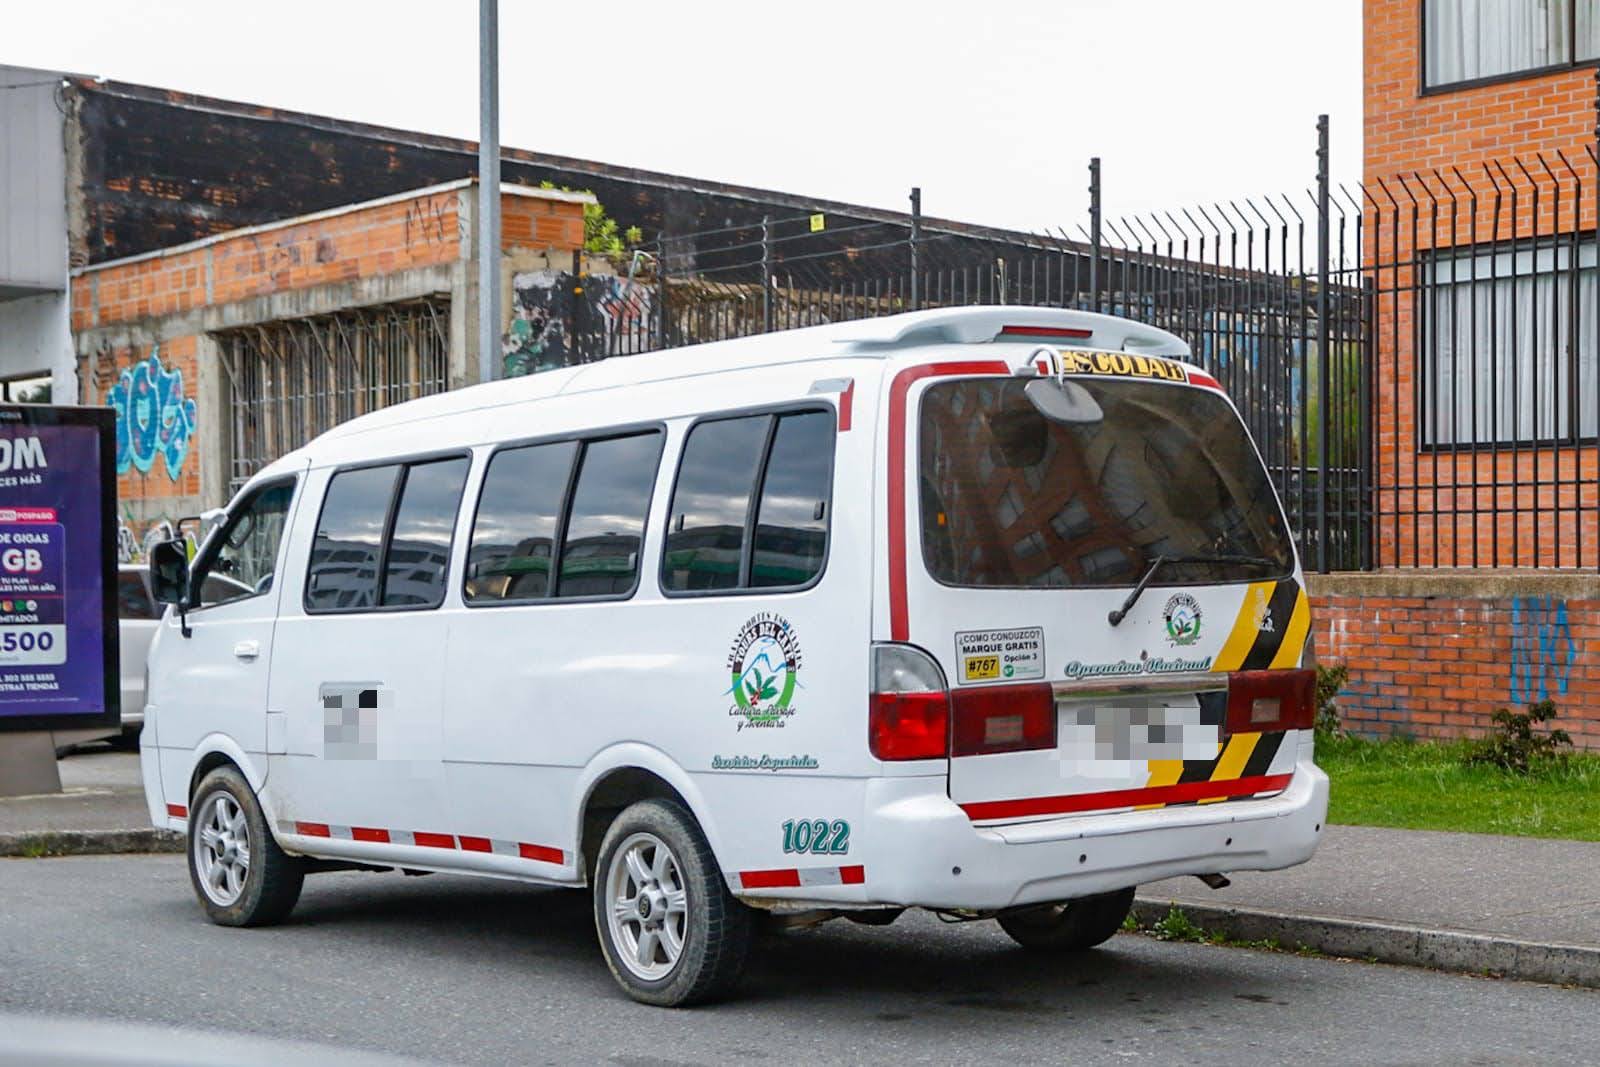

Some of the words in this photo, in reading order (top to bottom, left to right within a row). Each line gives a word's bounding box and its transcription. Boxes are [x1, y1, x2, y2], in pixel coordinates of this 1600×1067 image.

[1054, 350, 1185, 382] ESCOLAR
[13, 533, 49, 544] GIGAS
[2, 548, 43, 572] GB
[990, 630, 1040, 642] CONDUZCO?
[962, 643, 1003, 654] MARQUE
[1005, 641, 1038, 651] GRATIS
[968, 659, 996, 673] #767
[782, 818, 850, 855] 1022
